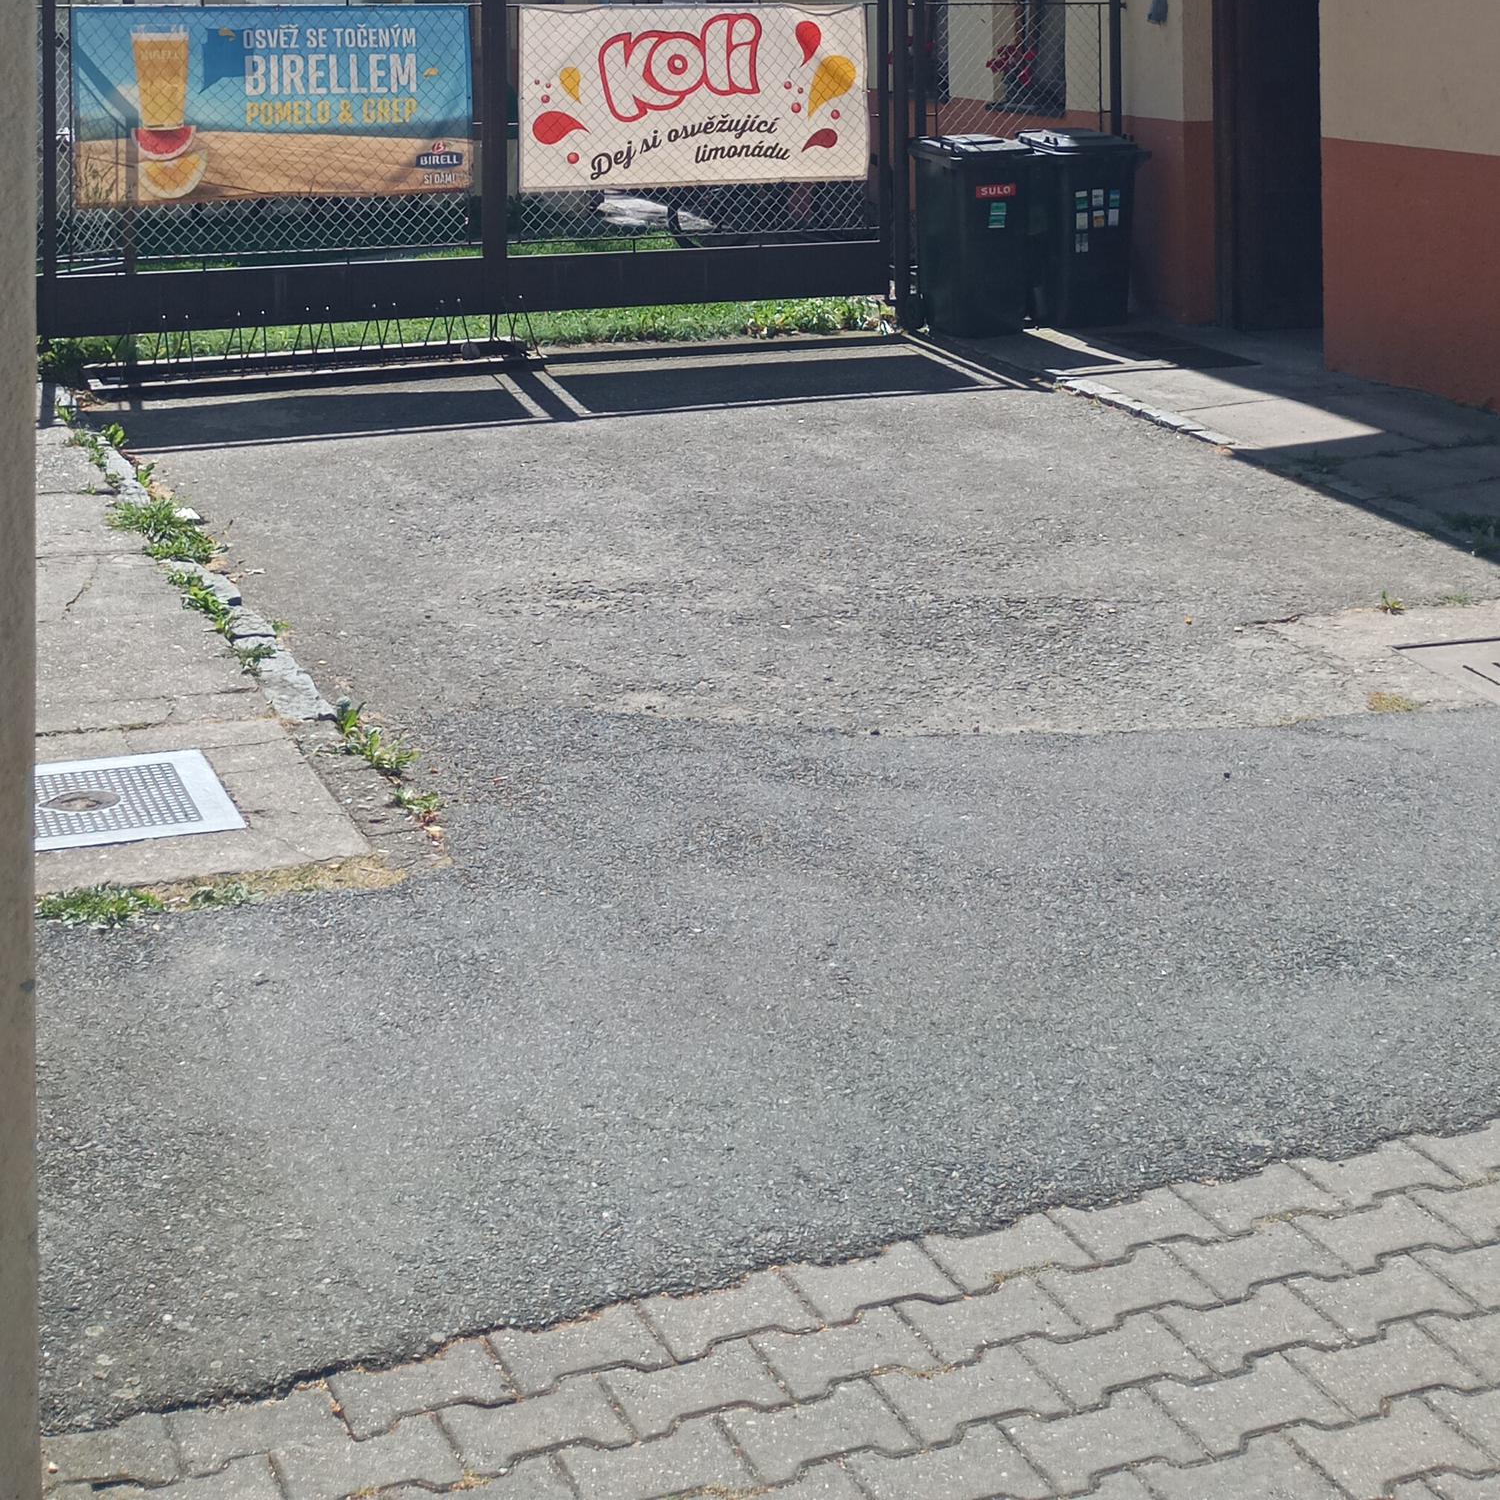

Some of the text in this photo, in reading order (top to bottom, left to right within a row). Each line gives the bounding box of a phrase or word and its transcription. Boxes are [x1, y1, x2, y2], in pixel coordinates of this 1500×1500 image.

[243, 23, 416, 49] OSVĚŽ SE TOČENÝM
[244, 53, 417, 96] BIRELLEM
[246, 97, 417, 125] POMELO & GREP
[590, 112, 780, 180] Dej si osvěžující
[694, 142, 790, 165] limonádu
[420, 155, 460, 165] BIRELL
[424, 174, 432, 184] SI
[980, 186, 1011, 196] SULO
